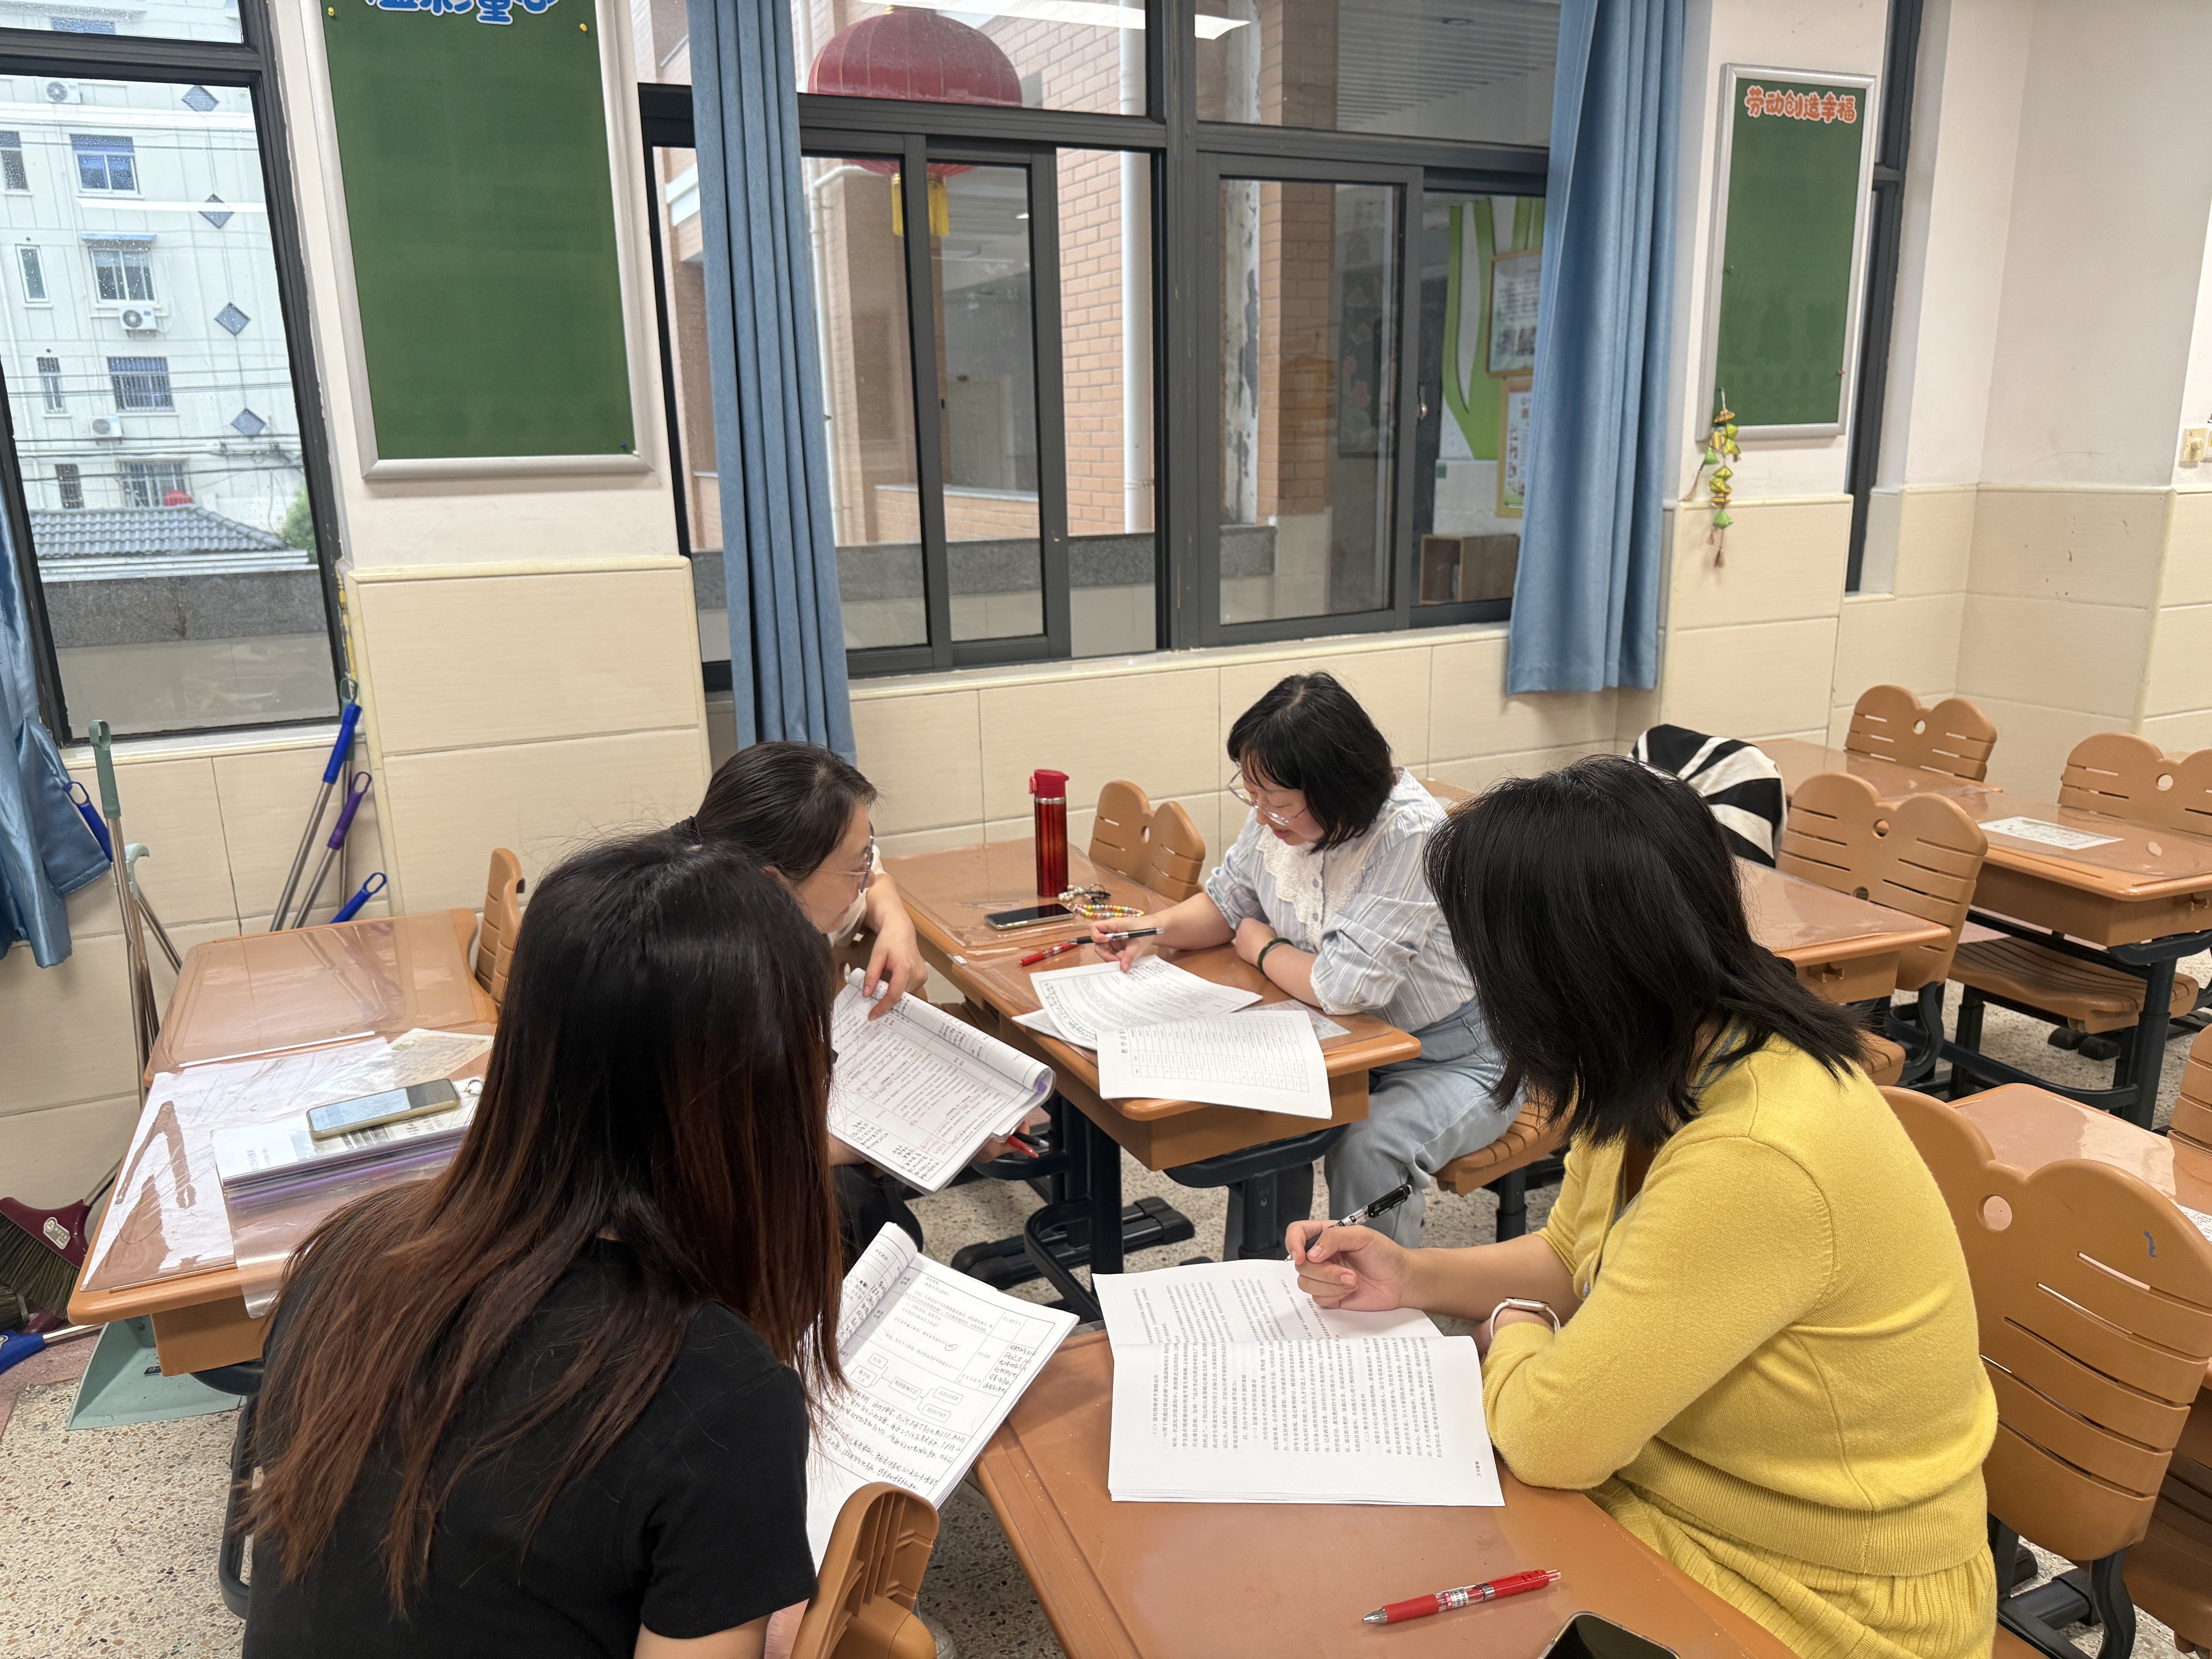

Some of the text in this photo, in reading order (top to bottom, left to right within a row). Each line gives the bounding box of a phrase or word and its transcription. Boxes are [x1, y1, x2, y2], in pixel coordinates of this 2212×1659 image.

[1745, 86, 1856, 124] 劳动创造幸福
[1361, 1394, 1370, 1441] （二）整合多元资源支持
